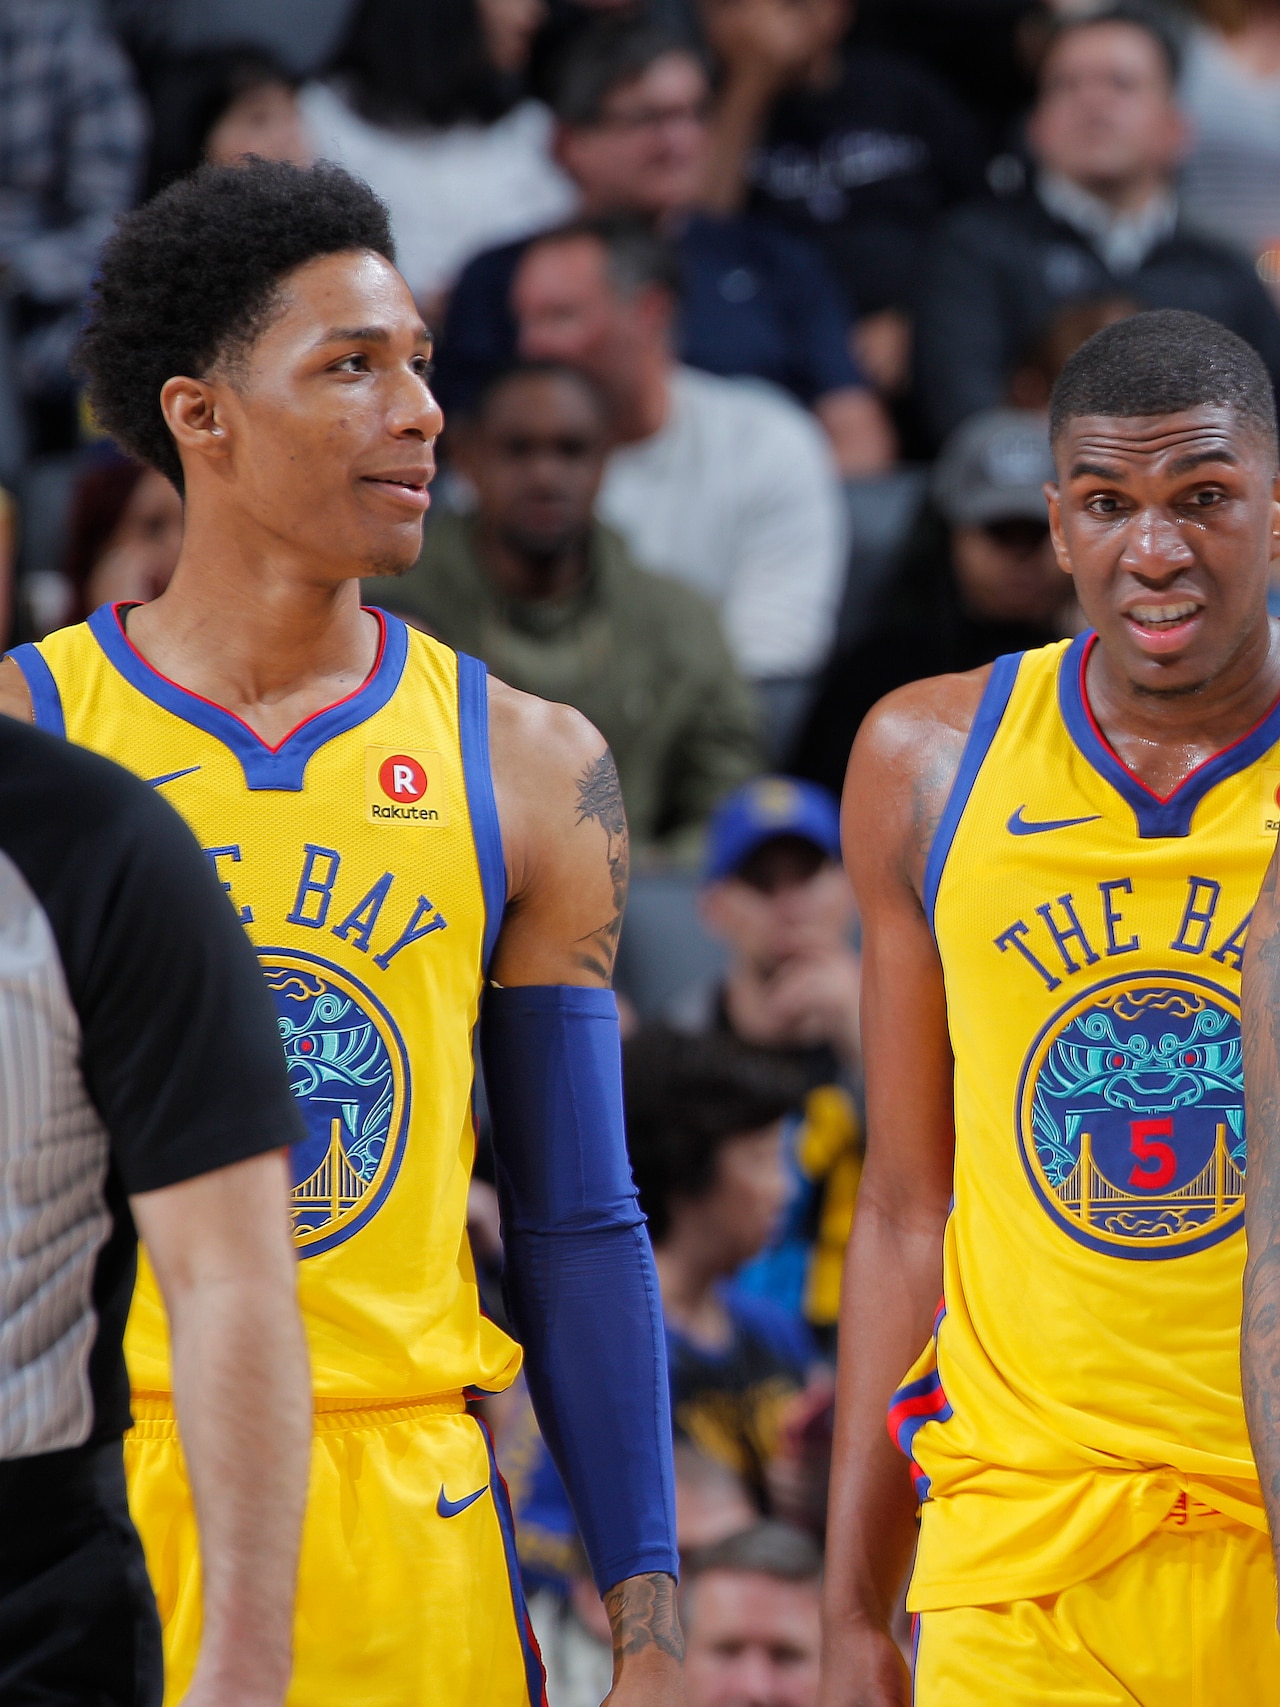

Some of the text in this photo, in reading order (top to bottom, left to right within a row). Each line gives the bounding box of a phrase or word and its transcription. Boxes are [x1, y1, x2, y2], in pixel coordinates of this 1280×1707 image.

[371, 805, 439, 821] Rakuten
[393, 764, 418, 795] R
[286, 843, 448, 971] BAY
[993, 875, 1254, 992] THE BA
[1128, 1115, 1177, 1190] 5
